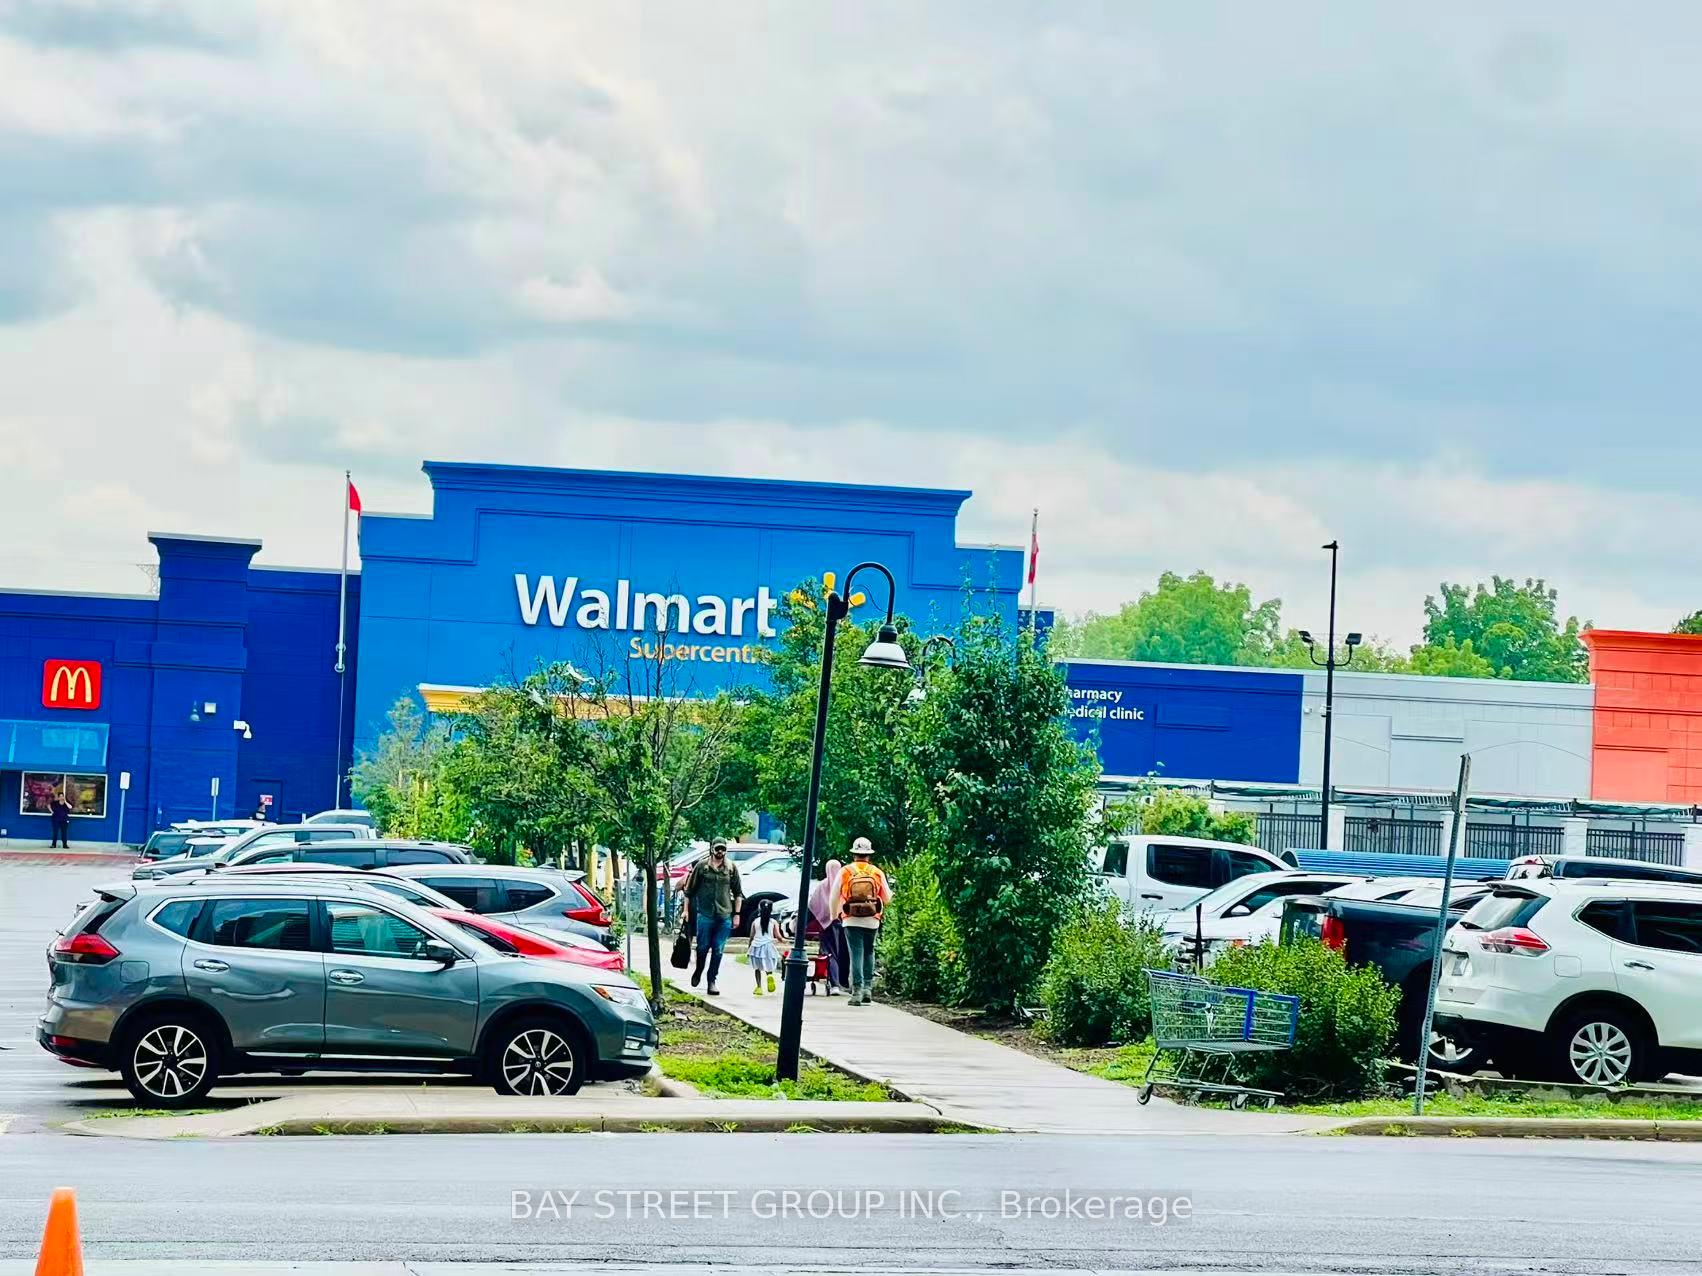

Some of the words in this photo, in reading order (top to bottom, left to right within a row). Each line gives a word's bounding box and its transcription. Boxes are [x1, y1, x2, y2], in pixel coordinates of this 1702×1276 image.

[514, 573, 778, 638] Walmart
[629, 636, 770, 664] Supercent
[1060, 685, 1123, 704] harmacy
[1060, 704, 1107, 719] edical
[1109, 706, 1145, 720] clinic
